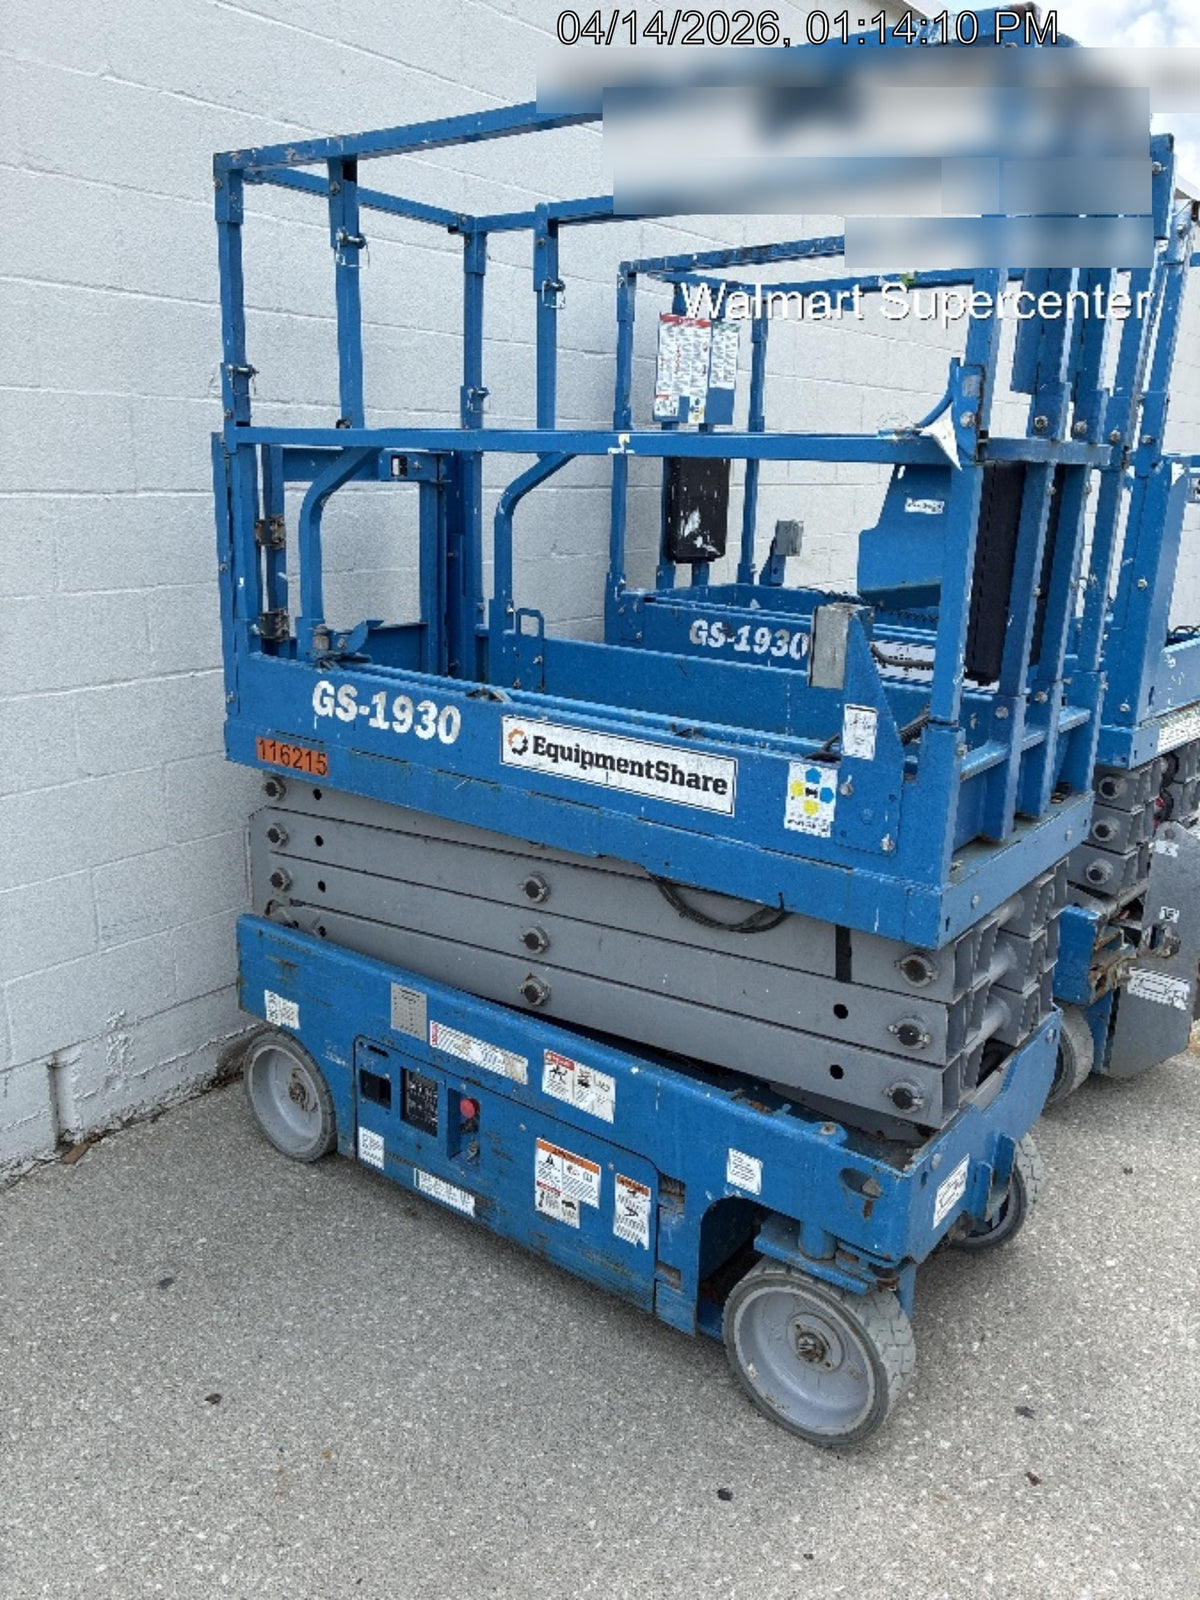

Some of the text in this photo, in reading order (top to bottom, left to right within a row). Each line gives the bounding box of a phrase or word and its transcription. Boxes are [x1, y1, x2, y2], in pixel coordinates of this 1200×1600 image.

[689, 618, 810, 660] GS-1930
[312, 680, 461, 745] GS-1930
[258, 738, 328, 775] 116215
[532, 735, 728, 796] EquipmentShare
